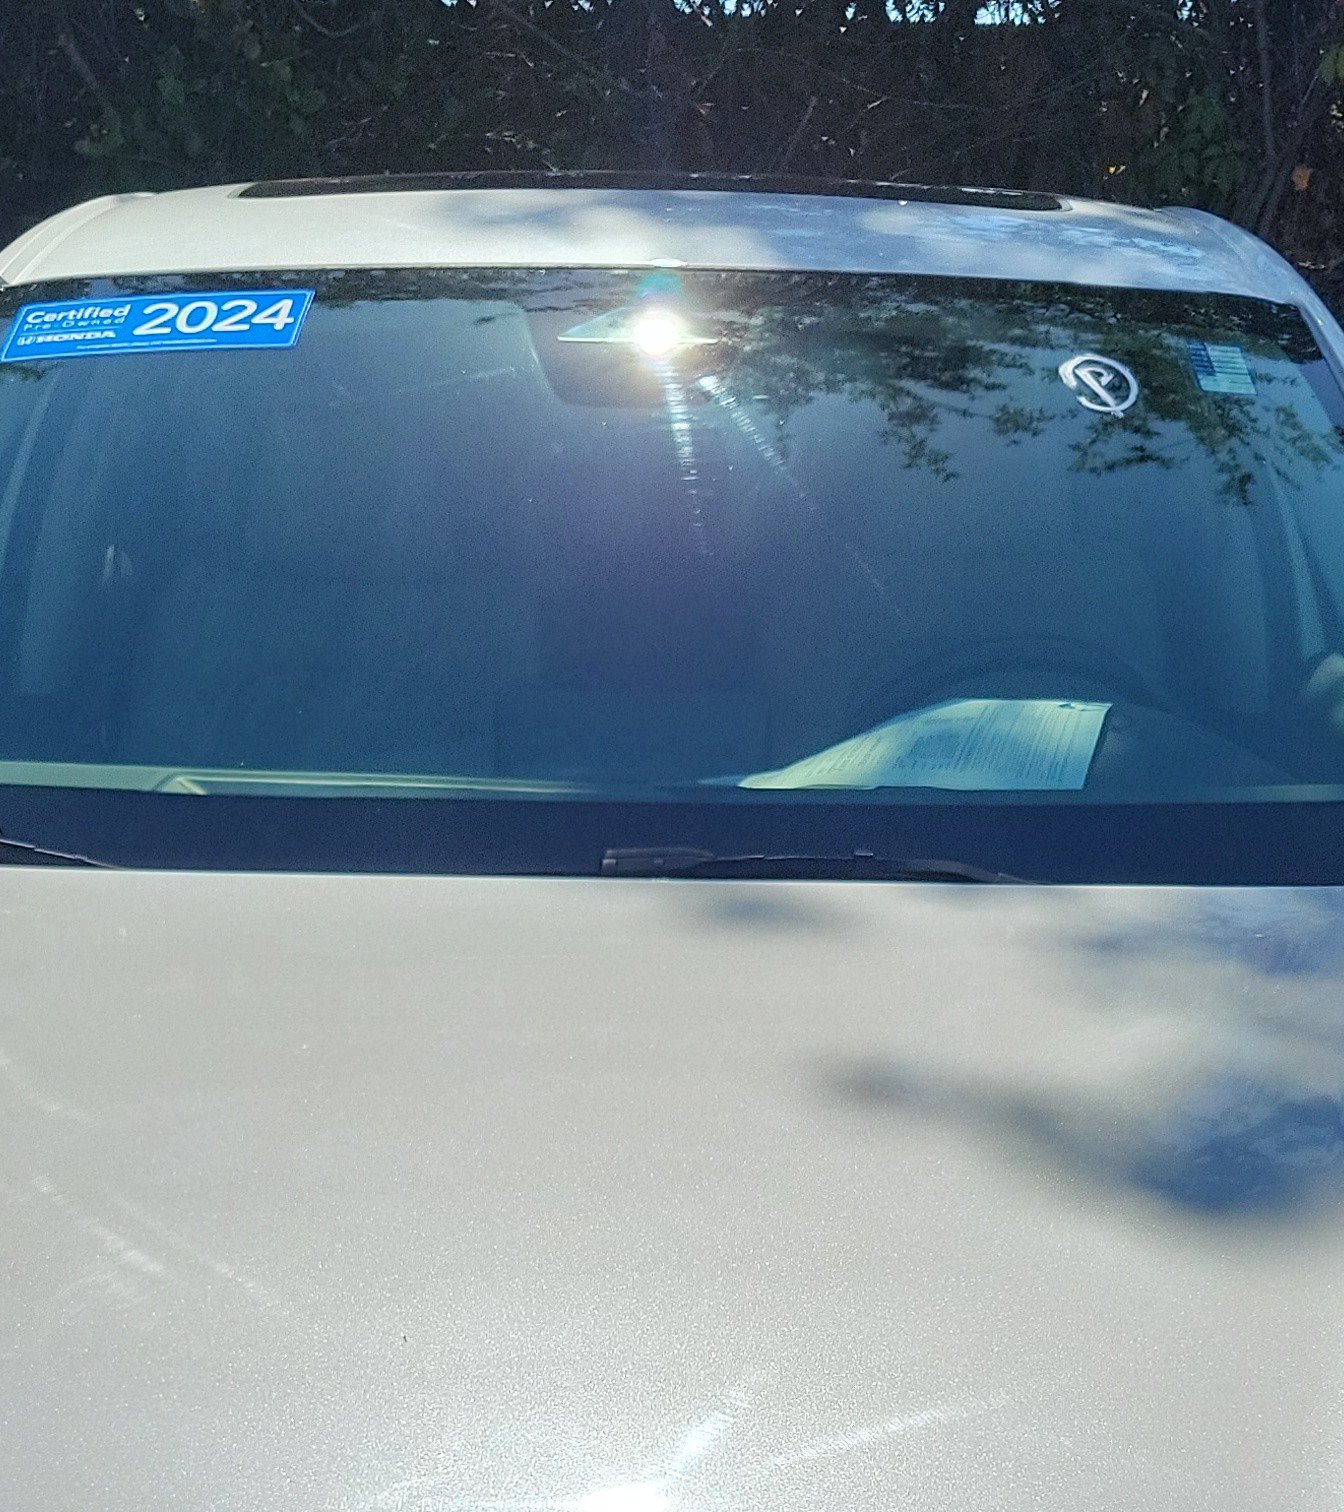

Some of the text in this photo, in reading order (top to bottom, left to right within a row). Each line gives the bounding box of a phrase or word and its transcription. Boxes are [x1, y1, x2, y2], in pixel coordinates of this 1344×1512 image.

[26, 304, 131, 324] Certified
[132, 299, 295, 336] 2024
[23, 317, 125, 332] Pre-Owned
[36, 330, 116, 343] HONDA
